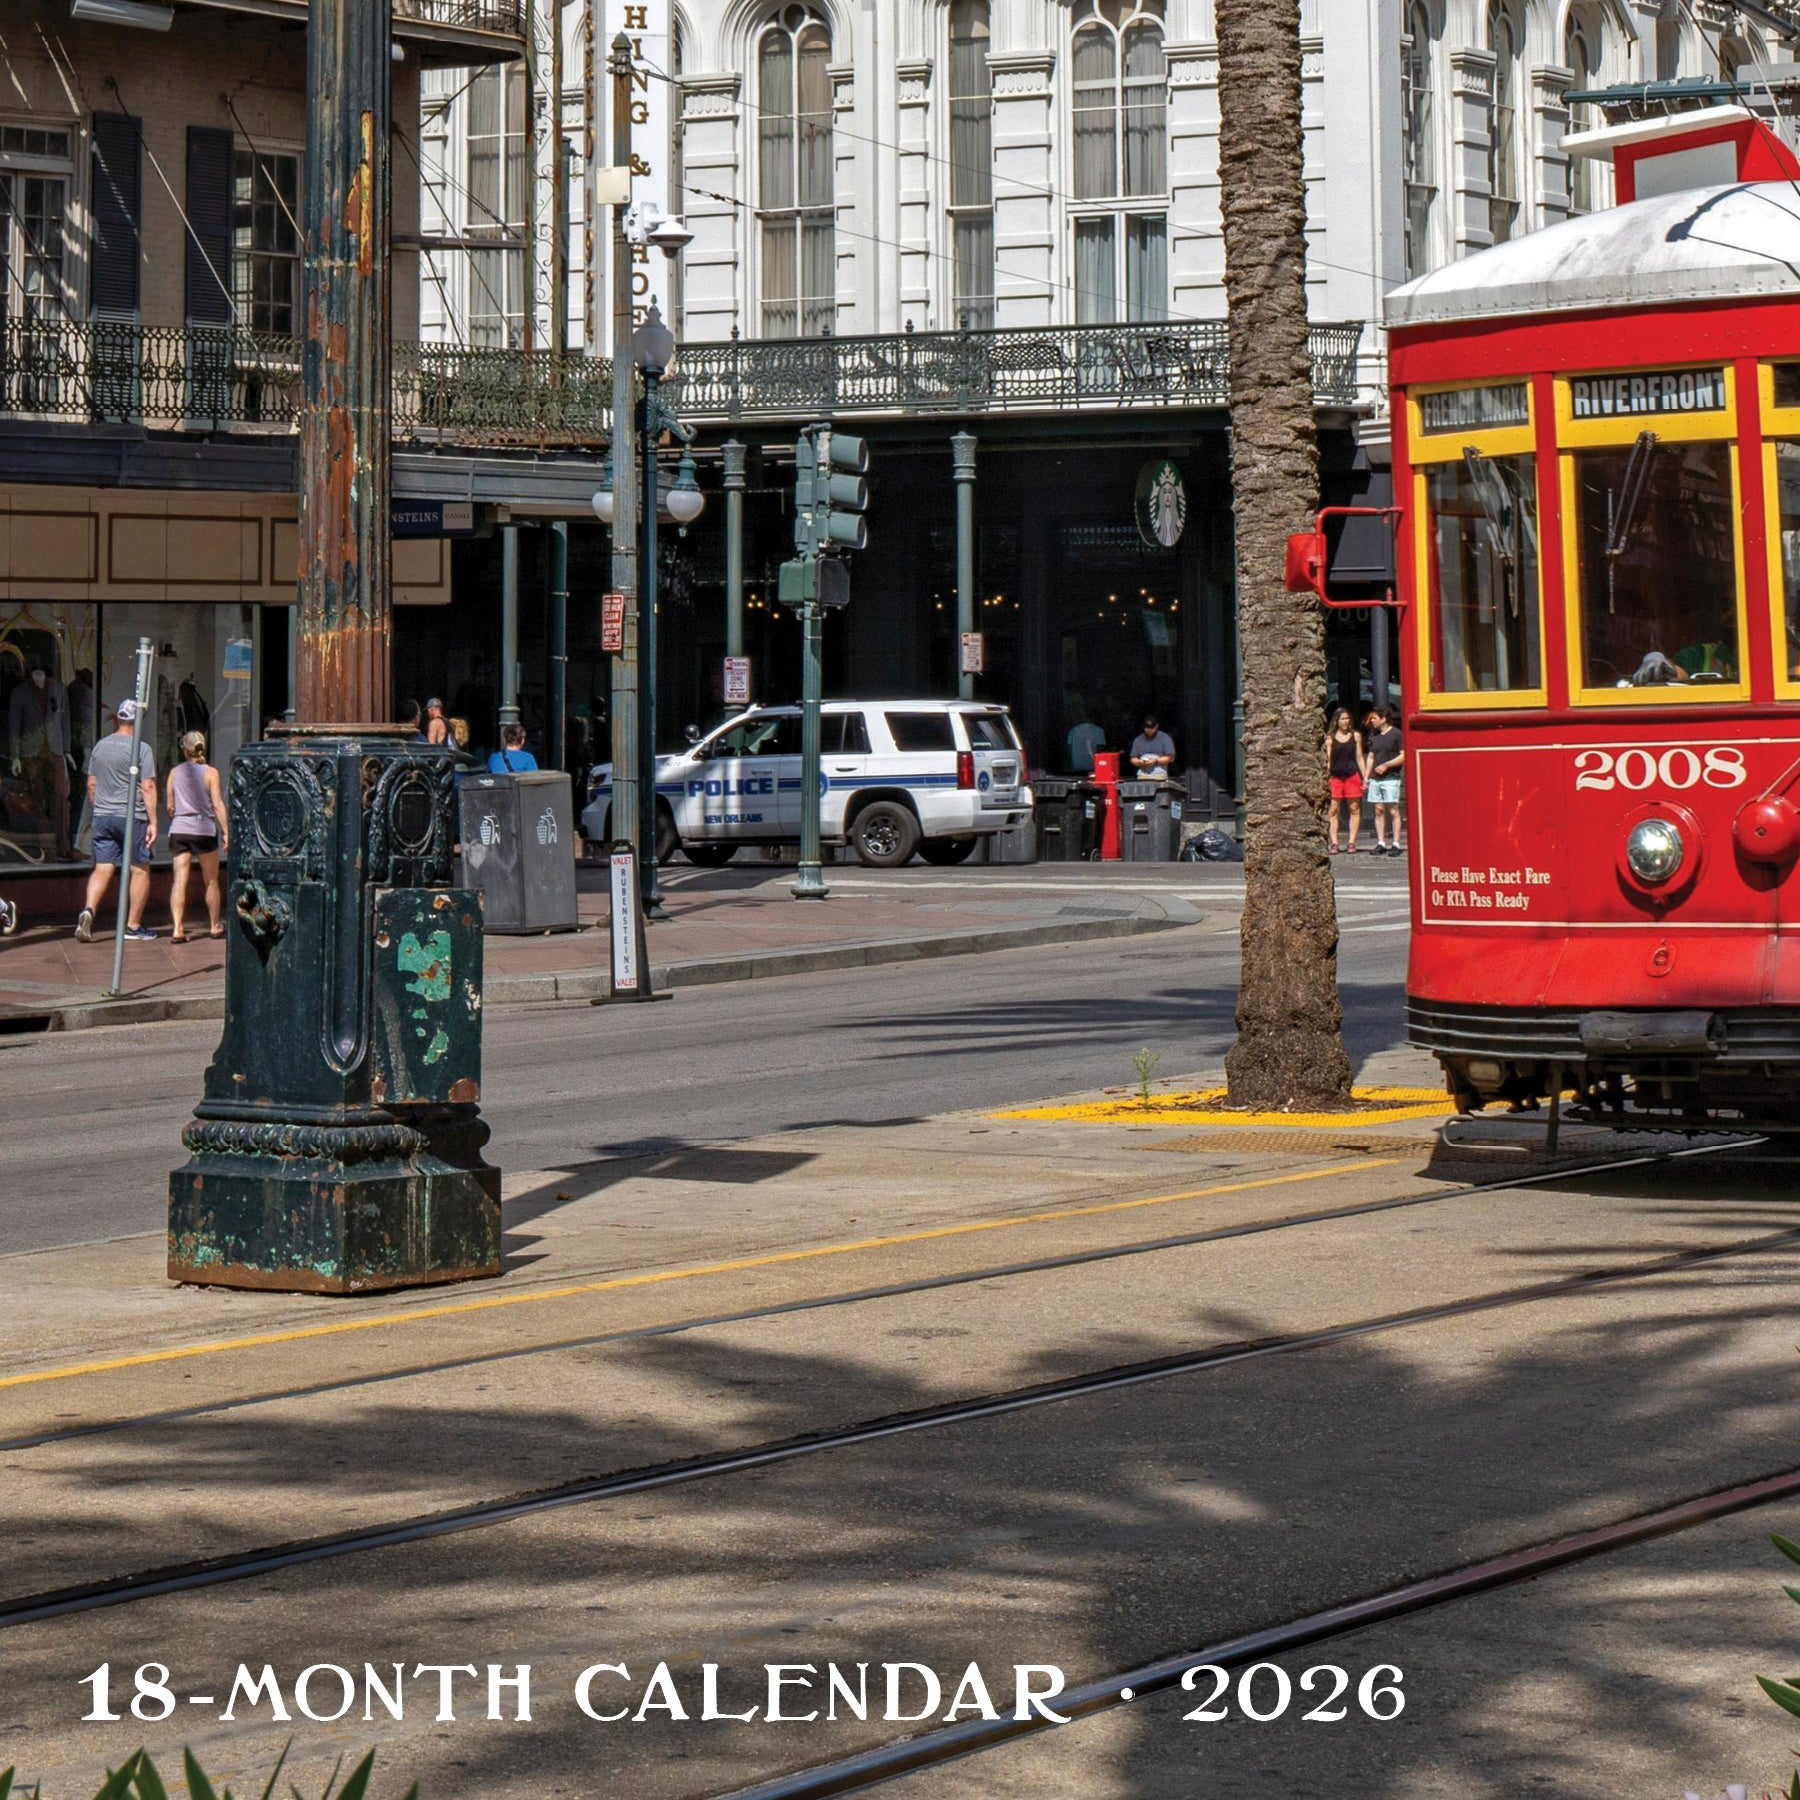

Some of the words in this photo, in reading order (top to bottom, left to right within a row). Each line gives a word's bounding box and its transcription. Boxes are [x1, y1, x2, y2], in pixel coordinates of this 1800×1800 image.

[1574, 371, 1727, 417] RIVERFRONT
[1424, 389, 1477, 428] FRENCH
[1481, 386, 1529, 422] MARKE
[1574, 747, 1747, 791] 2008
[688, 778, 774, 798] POLICE
[704, 814, 722, 824] NEW
[724, 813, 763, 823] ORLEANS
[613, 856, 632, 865] VALET
[1431, 866, 1459, 884] Please
[1462, 866, 1486, 884] Have
[1489, 867, 1521, 885] Exact
[1524, 867, 1551, 885] Fare
[1432, 890, 1445, 907] Or
[1447, 890, 1468, 907] RTA
[1469, 891, 1492, 908] Pass
[1495, 890, 1530, 910] Ready
[620, 868, 630, 974] RUBENSTEINS
[615, 978, 637, 987] VALET
